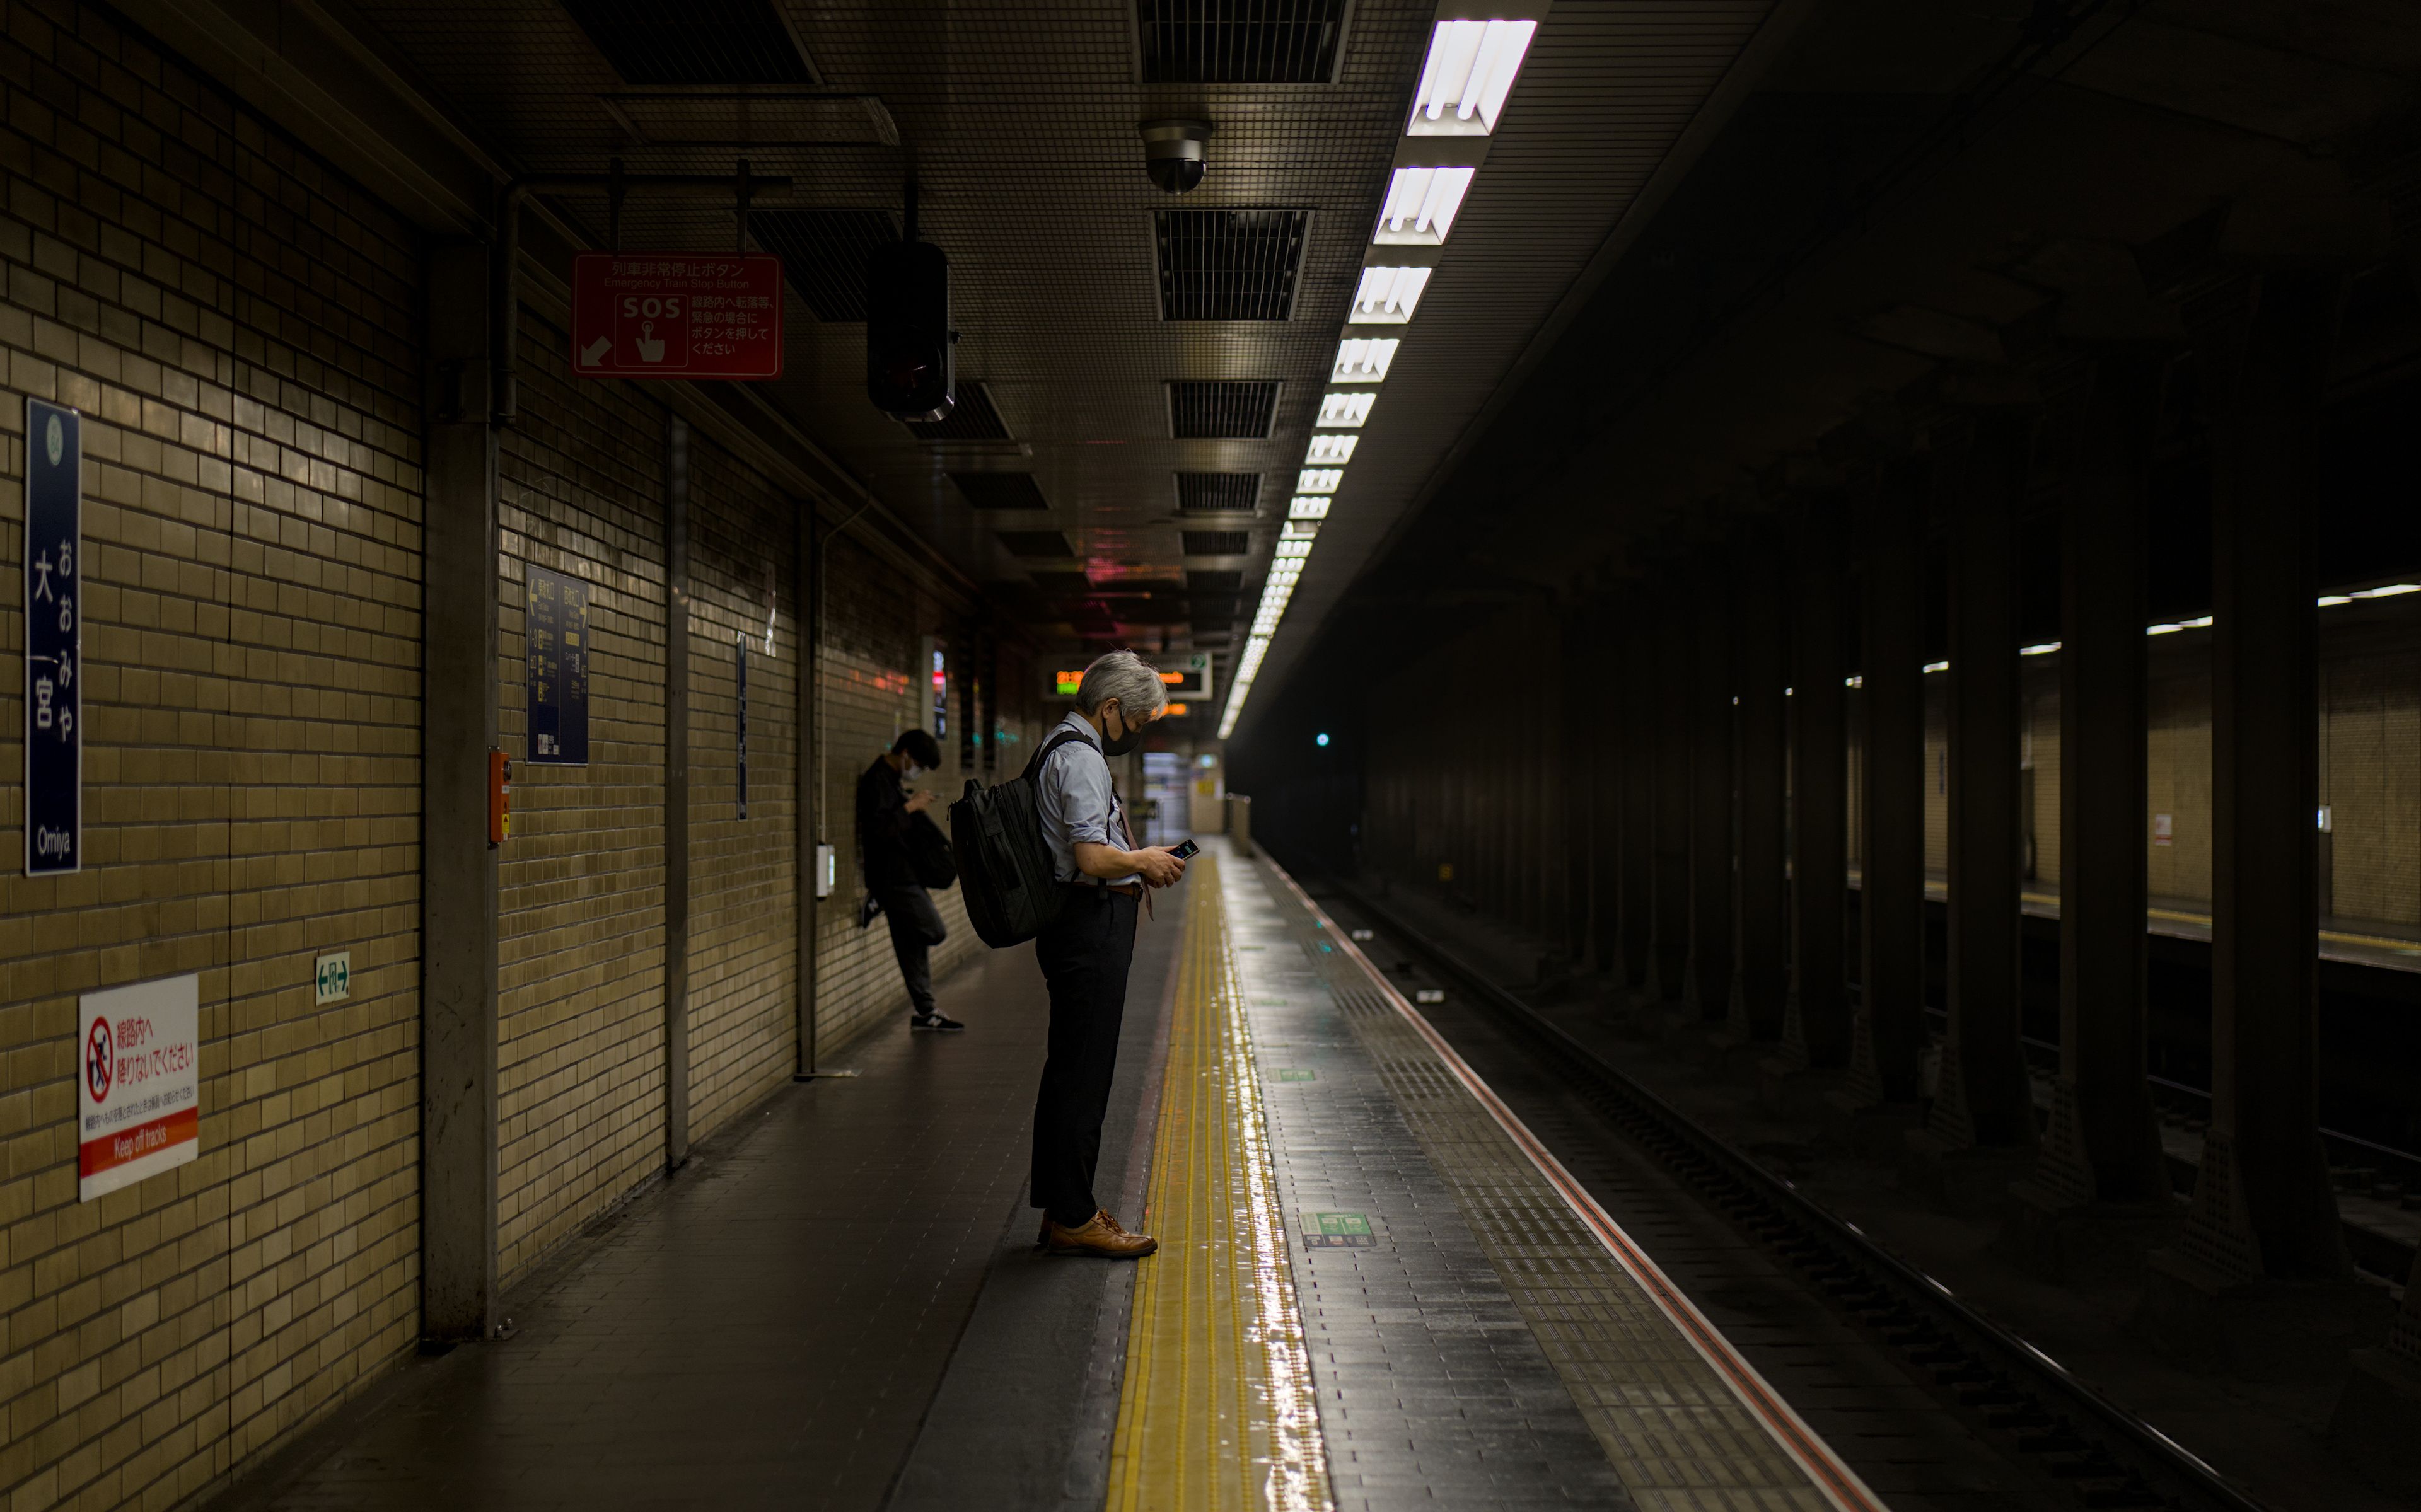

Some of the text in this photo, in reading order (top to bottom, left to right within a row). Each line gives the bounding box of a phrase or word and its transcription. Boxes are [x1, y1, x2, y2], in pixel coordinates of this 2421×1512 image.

[611, 261, 744, 277] 列車非常停止ボタン
[605, 277, 749, 290] Emergency Train Stop Button
[623, 297, 681, 319] SOS
[692, 311, 758, 324] 緊急の場合に
[692, 326, 769, 340] ボタンを押して
[692, 342, 736, 355] ください
[35, 547, 53, 729] 大宮
[58, 539, 73, 744] おおみや
[37, 823, 71, 862] Omiya
[117, 1015, 153, 1050] 線路内へ
[117, 1042, 194, 1089] 降りないでください
[113, 1124, 167, 1160] Keep off tracks
